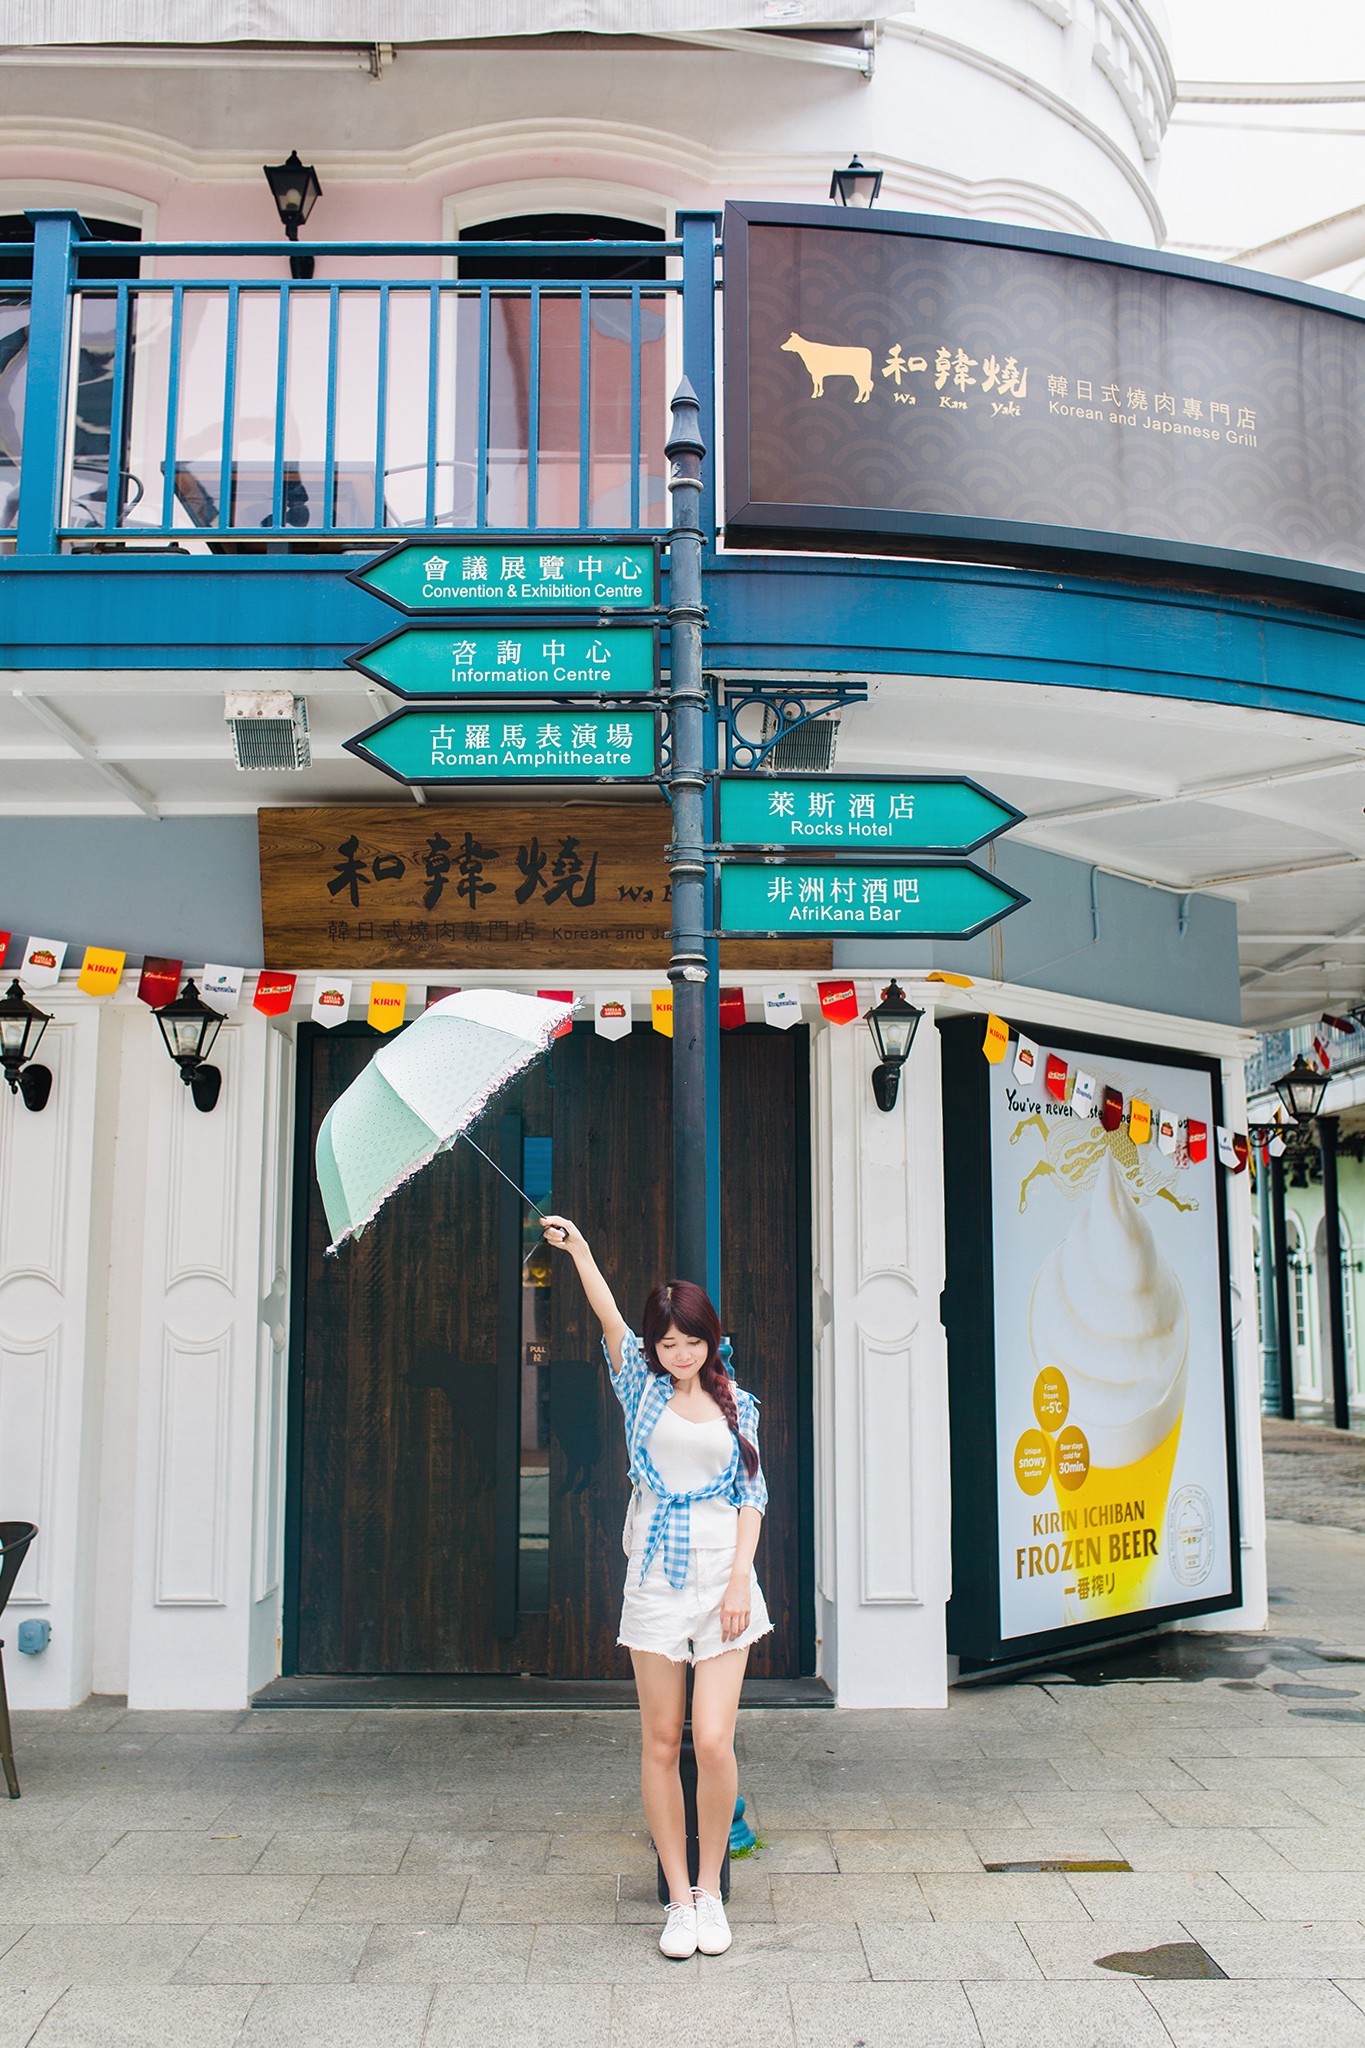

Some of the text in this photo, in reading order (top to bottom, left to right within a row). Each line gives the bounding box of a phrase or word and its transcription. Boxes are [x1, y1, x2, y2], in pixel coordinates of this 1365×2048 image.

[881, 343, 1028, 398] 和韓燒
[893, 392, 1021, 418] Wa Kan Yaki
[1047, 374, 1256, 430] 韓日式燒肉專門店
[1049, 401, 1257, 448] Korean and Japanese Grill
[422, 555, 642, 581] 會議展覽中心
[422, 584, 642, 598] Convention & Exhibition Centre
[452, 639, 611, 666] 咨詢中心
[451, 668, 611, 682] Information Centre
[430, 723, 633, 750] 古羅馬表演場
[431, 751, 631, 767] Roman Amphitheatre
[767, 791, 915, 819] 萊斯酒店
[791, 821, 893, 837] Rocks Hotel
[326, 832, 599, 910] 和韓燒
[617, 885, 654, 903] Wa
[767, 877, 920, 904] 非洲村酒吧
[789, 906, 901, 921] AfriKana Bar
[327, 920, 536, 942] 韓日式燒肉專門店
[552, 927, 609, 940] Korean
[616, 927, 645, 940] and
[87, 963, 118, 975] KIRIN
[373, 998, 401, 1007] KIRIN
[989, 1028, 1006, 1042] KIRIN
[1005, 1088, 1041, 1115] You've
[530, 1345, 546, 1353] PULL
[1044, 1383, 1058, 1391] Foam
[1018, 1456, 1046, 1469] snowy
[1059, 1461, 1086, 1475] 30min.
[1033, 1500, 1145, 1536] KIRIN ICHIBAN
[1016, 1536, 1101, 1579] FROZEN
[1109, 1528, 1159, 1563] BEER
